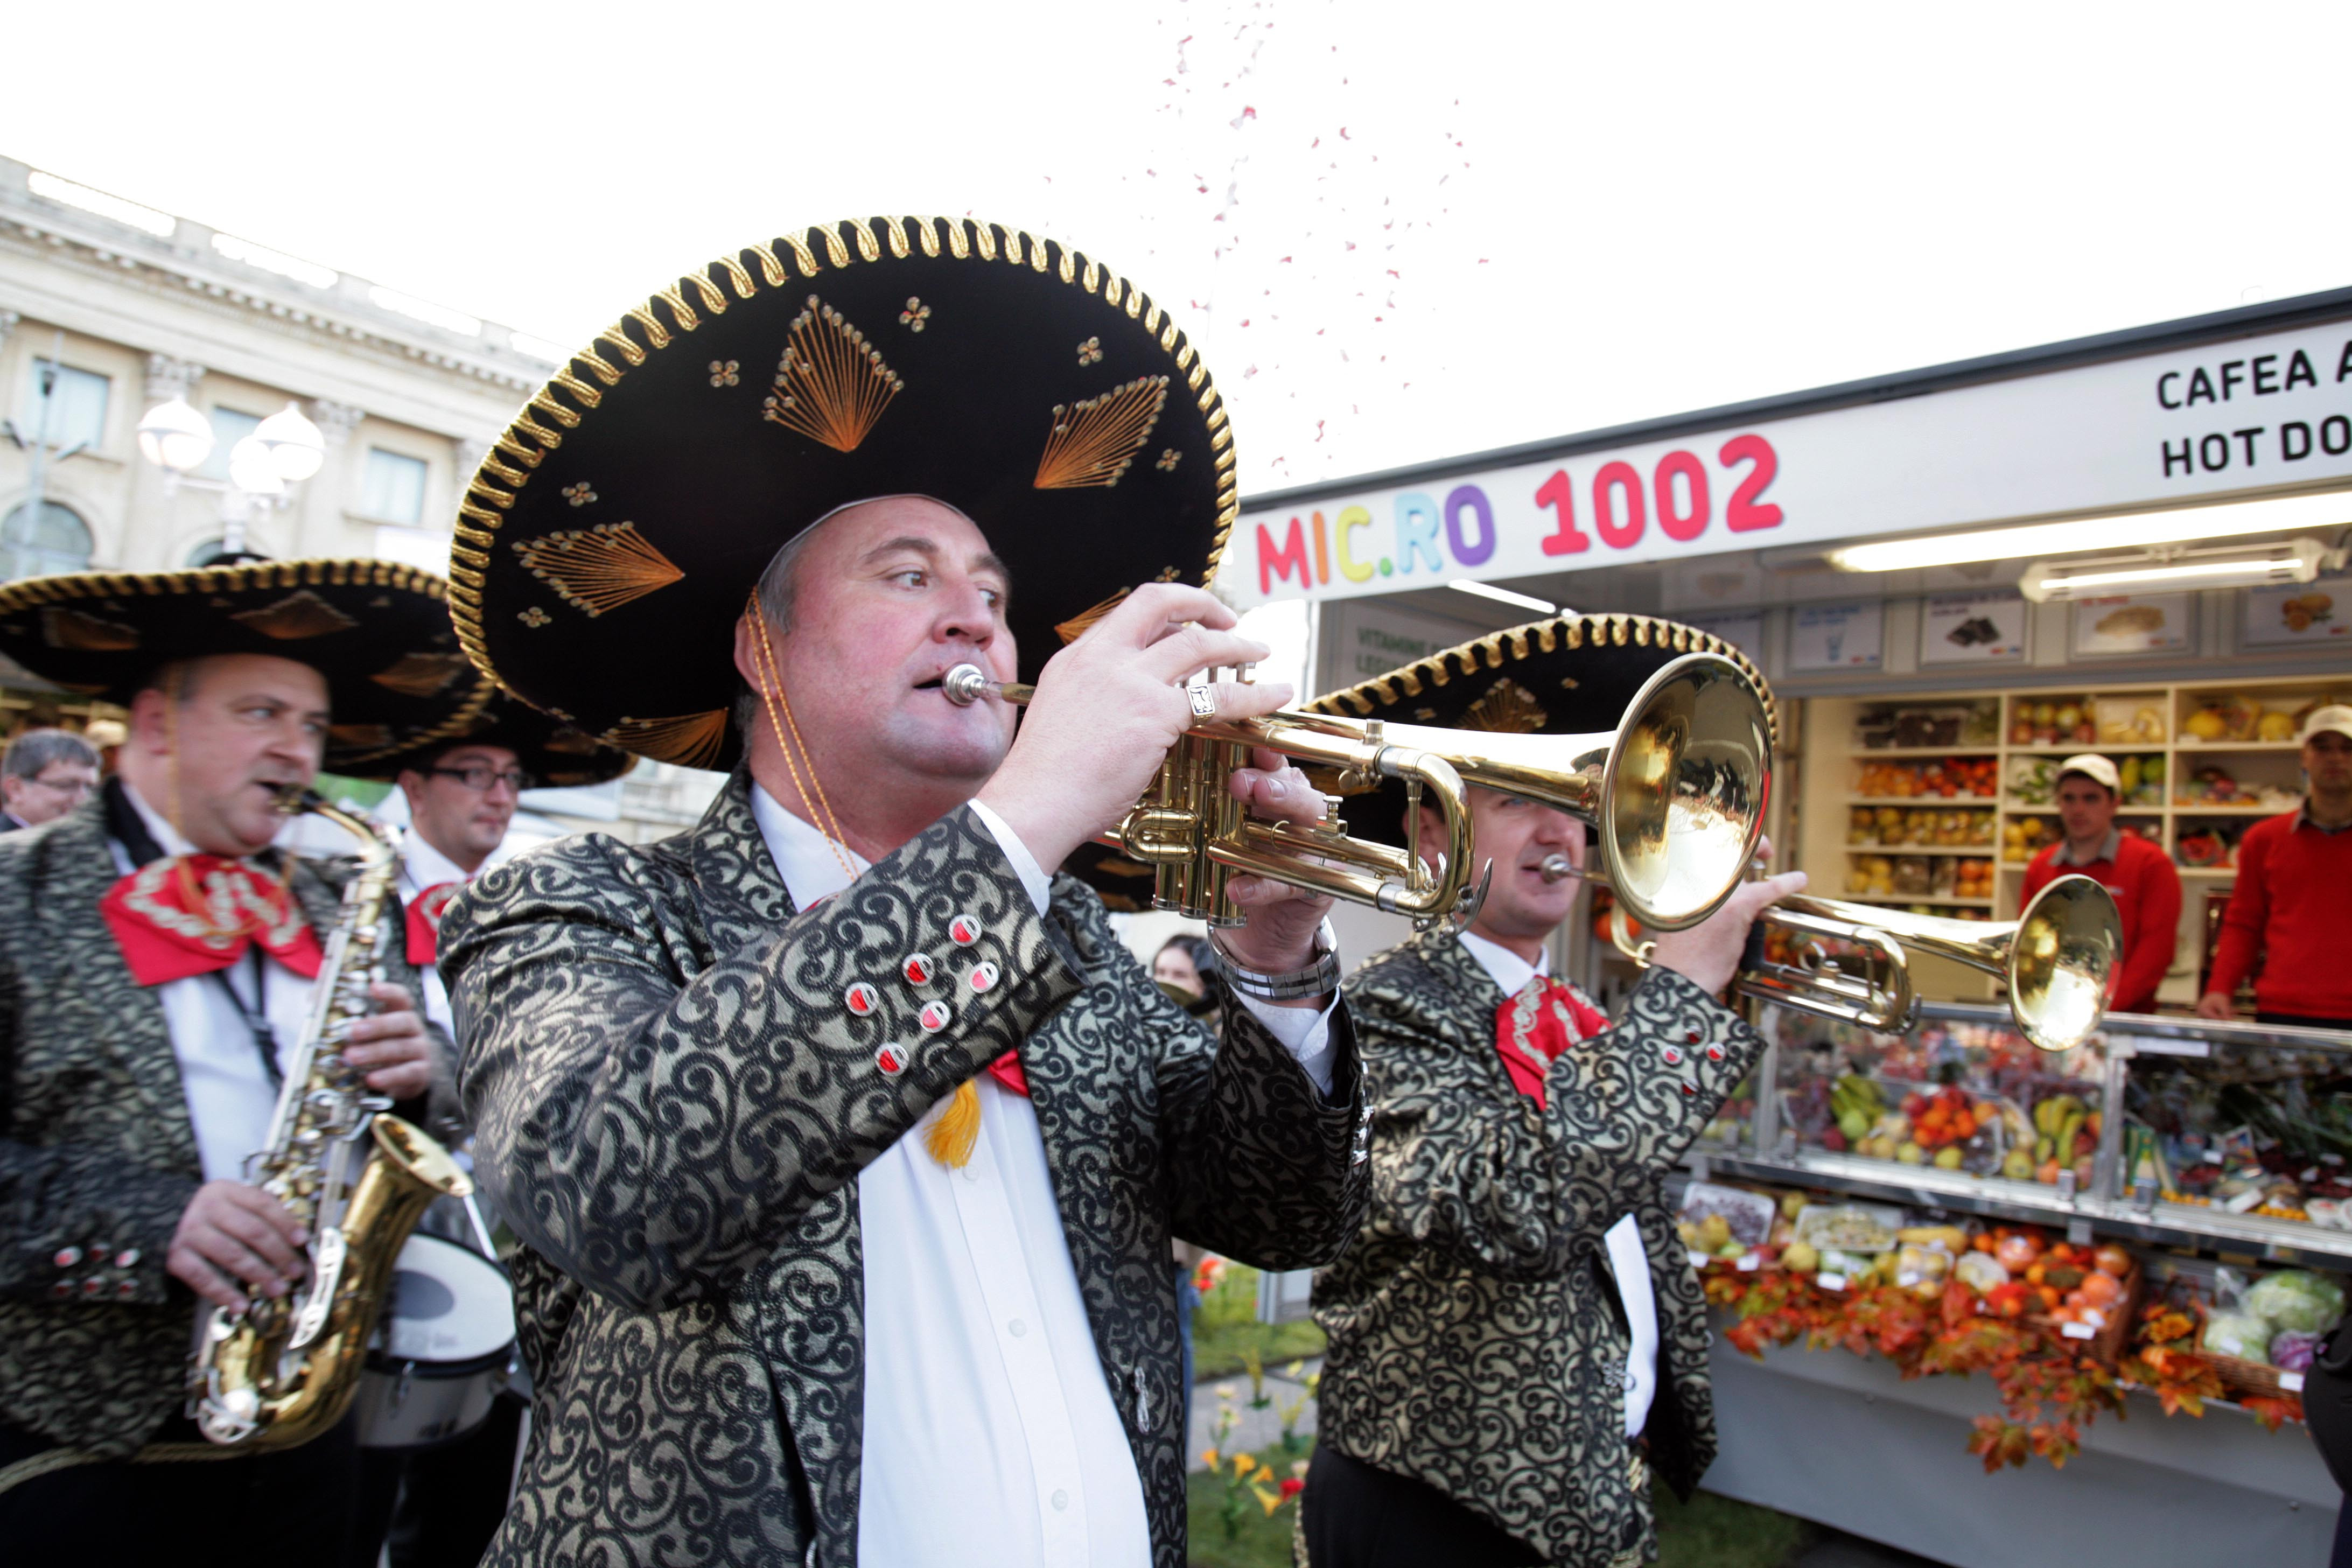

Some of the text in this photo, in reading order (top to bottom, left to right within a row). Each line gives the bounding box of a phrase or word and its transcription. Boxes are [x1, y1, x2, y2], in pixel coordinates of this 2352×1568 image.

[2157, 349, 2318, 410] CAFEA
[2161, 415, 2352, 478] HOT DO
[1255, 433, 1784, 595] MIC.RO 1002
